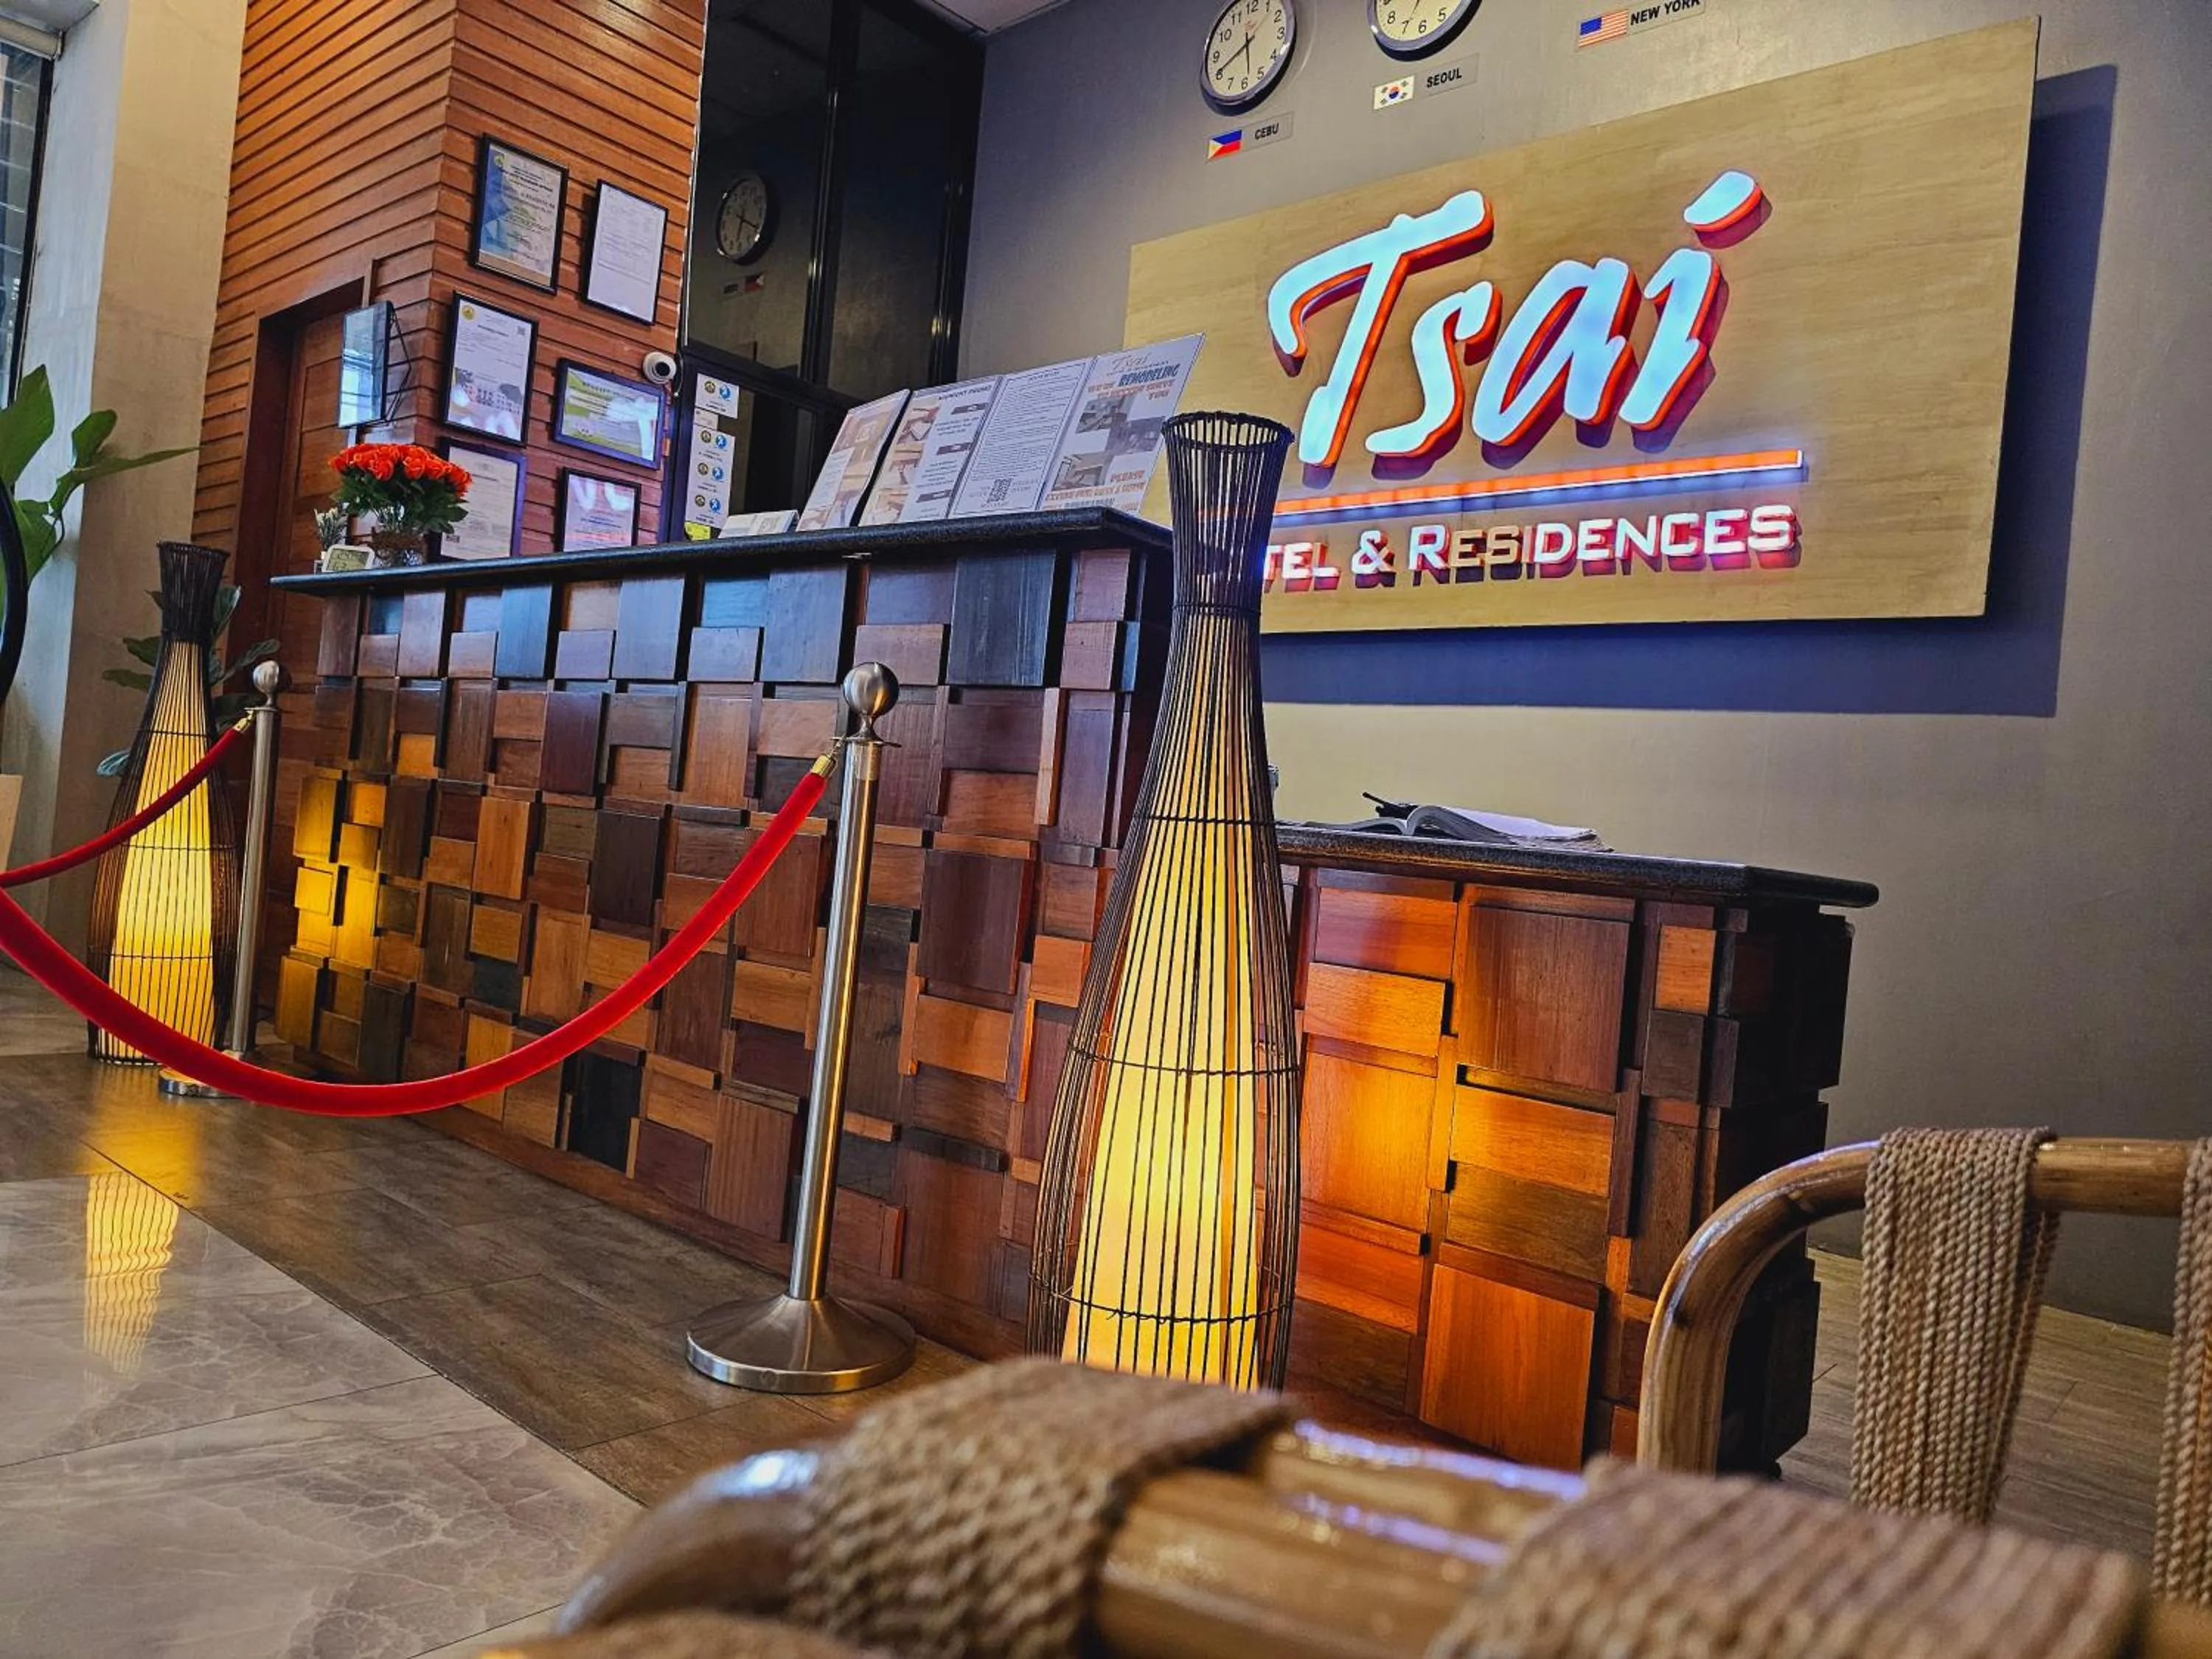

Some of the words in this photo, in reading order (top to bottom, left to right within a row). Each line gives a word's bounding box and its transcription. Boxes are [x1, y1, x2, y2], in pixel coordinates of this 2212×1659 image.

[1246, 0, 1259, 14] 12
[1265, 1, 1270, 13] 1
[1436, 7, 1447, 22] 5
[1231, 10, 1242, 25] 11
[1273, 10, 1282, 24] 2
[1387, 10, 1396, 24] 8
[1630, 5, 1661, 26] NEW
[1276, 26, 1285, 40] 3
[1402, 20, 1410, 35] 7
[1418, 19, 1427, 34] 6
[1220, 28, 1232, 43] 10
[1213, 51, 1220, 63] 9
[1270, 49, 1277, 60] 4
[1256, 66, 1265, 80] 5
[1426, 67, 1462, 88] SEOUL
[1228, 76, 1235, 90] 7
[1241, 76, 1248, 89] 6
[1254, 122, 1279, 140] CEBU
[1266, 170, 1764, 468] Tsai
[1117, 363, 1180, 387] REMODELING
[1262, 541, 1340, 579] TEL
[1351, 529, 1397, 574] &
[1408, 504, 1798, 571] RESIDENCES
